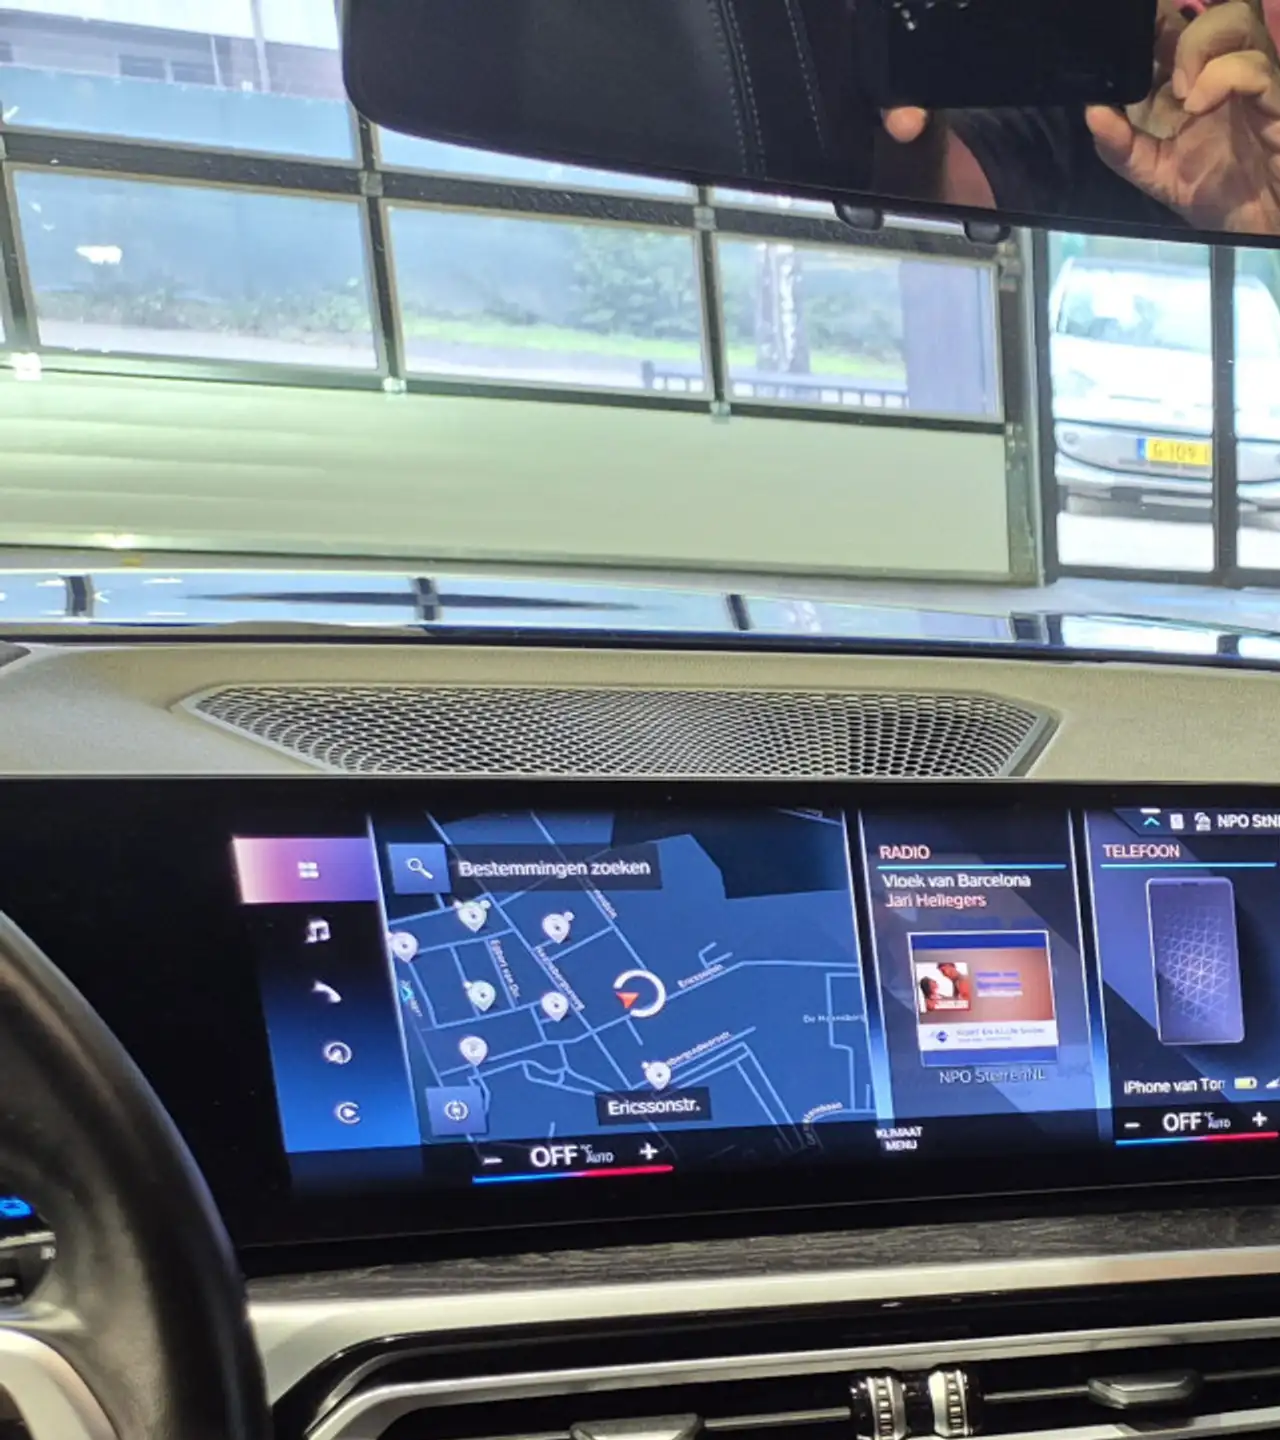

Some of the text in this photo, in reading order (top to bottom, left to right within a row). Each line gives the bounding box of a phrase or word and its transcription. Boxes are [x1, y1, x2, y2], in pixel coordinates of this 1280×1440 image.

[1217, 813, 1248, 828] NPO
[879, 845, 931, 859] RADIO
[1102, 844, 1180, 857] TELEFOON
[458, 859, 651, 878] Bestemmingen zoeken
[882, 873, 1032, 888] Vloek van Barcelona
[939, 1070, 971, 1084] NPO
[1124, 1079, 1170, 1094] iPhone
[1174, 1081, 1198, 1092] van
[607, 1098, 701, 1116] Ericssonstr.
[1162, 1112, 1202, 1132] OFF
[884, 1139, 918, 1150] MENU
[530, 1145, 578, 1167] OFF
